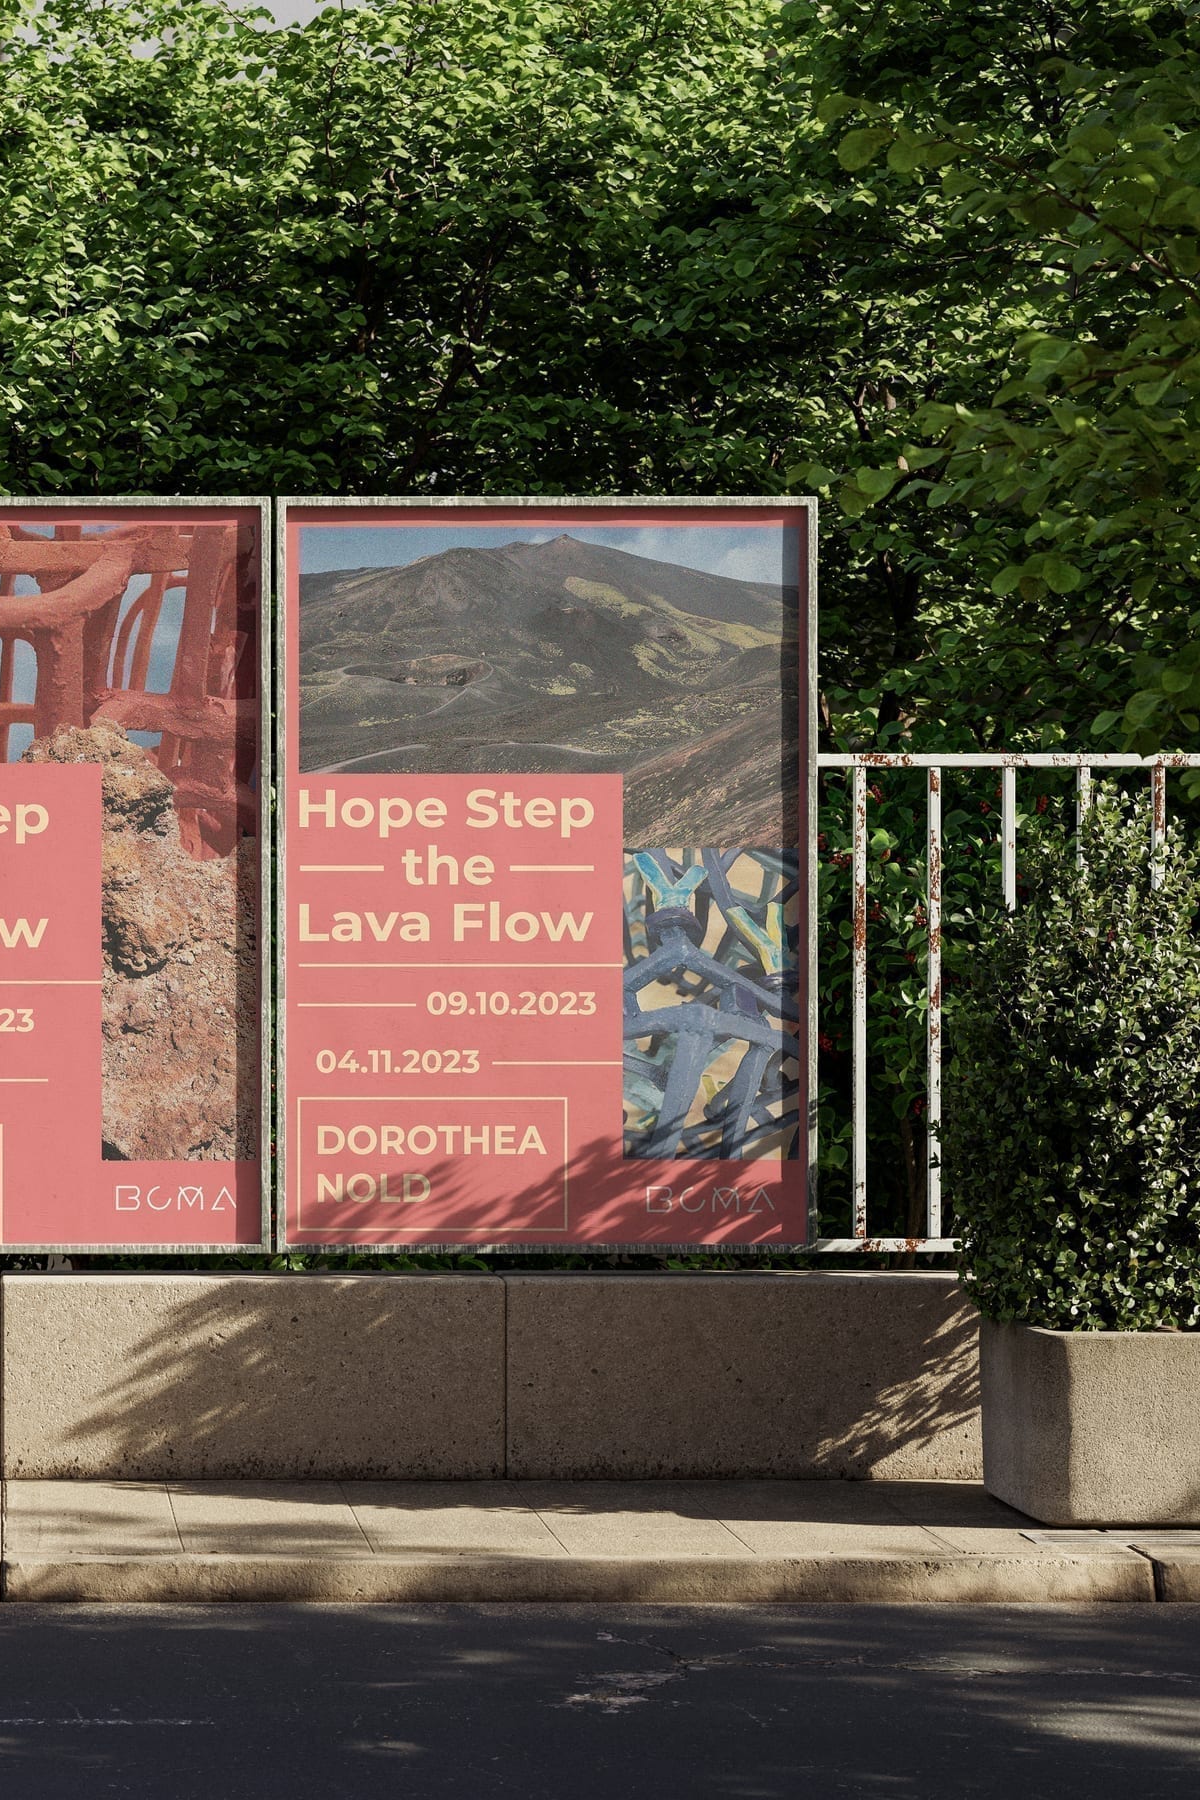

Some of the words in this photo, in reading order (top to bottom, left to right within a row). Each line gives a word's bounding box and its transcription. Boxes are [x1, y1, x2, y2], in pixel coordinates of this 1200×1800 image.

[298, 788, 448, 838] Hope
[464, 788, 594, 838] Step
[402, 845, 495, 886] the
[298, 903, 431, 943] Lava
[452, 901, 594, 943] Flow
[426, 991, 597, 1016] 09.10.2023
[316, 1050, 480, 1074] 04.11.2023
[316, 1125, 547, 1155] DOROTHEA
[316, 1173, 431, 1204] NOLD
